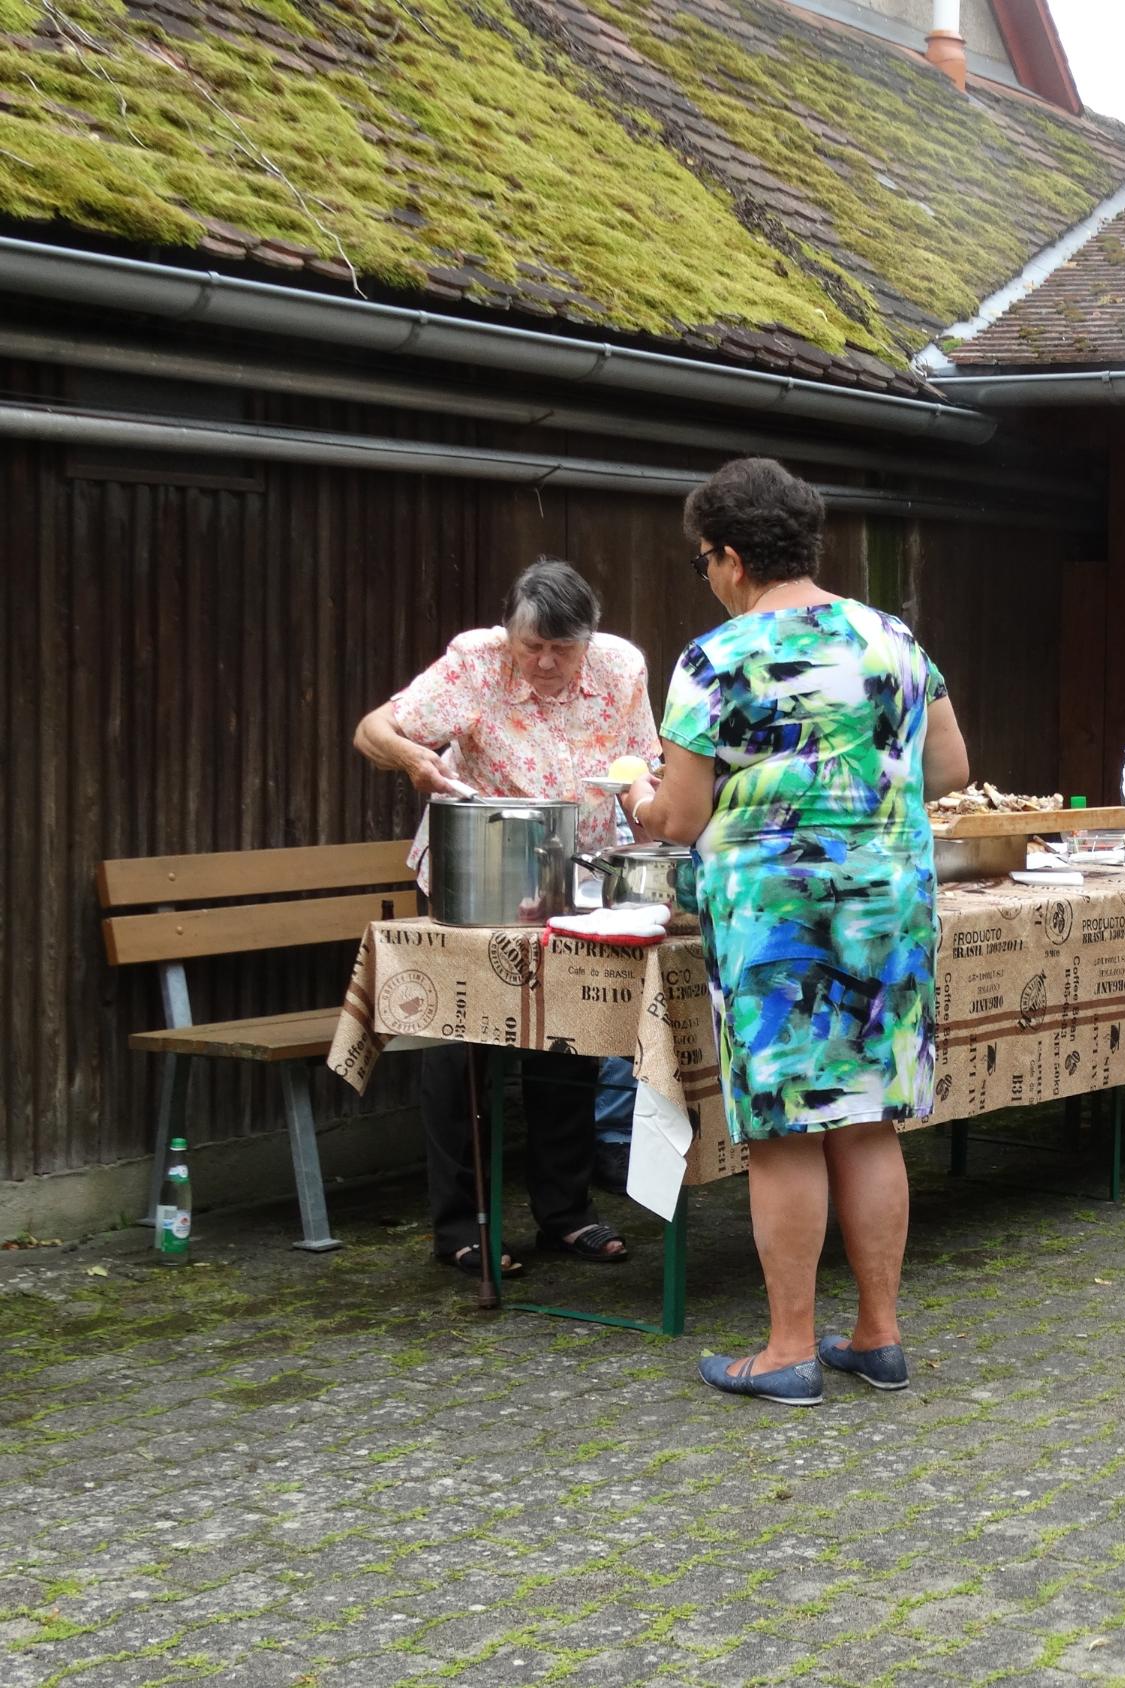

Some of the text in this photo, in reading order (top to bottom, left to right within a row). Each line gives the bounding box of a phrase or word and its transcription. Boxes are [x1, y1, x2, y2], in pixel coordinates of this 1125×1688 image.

[1082, 916, 1125, 932] PRODUCTO
[953, 928, 1002, 946] PRODUCTO
[551, 938, 645, 961] ESPRESSO
[604, 969, 636, 979] BRASIL
[581, 985, 632, 1003] B3110
